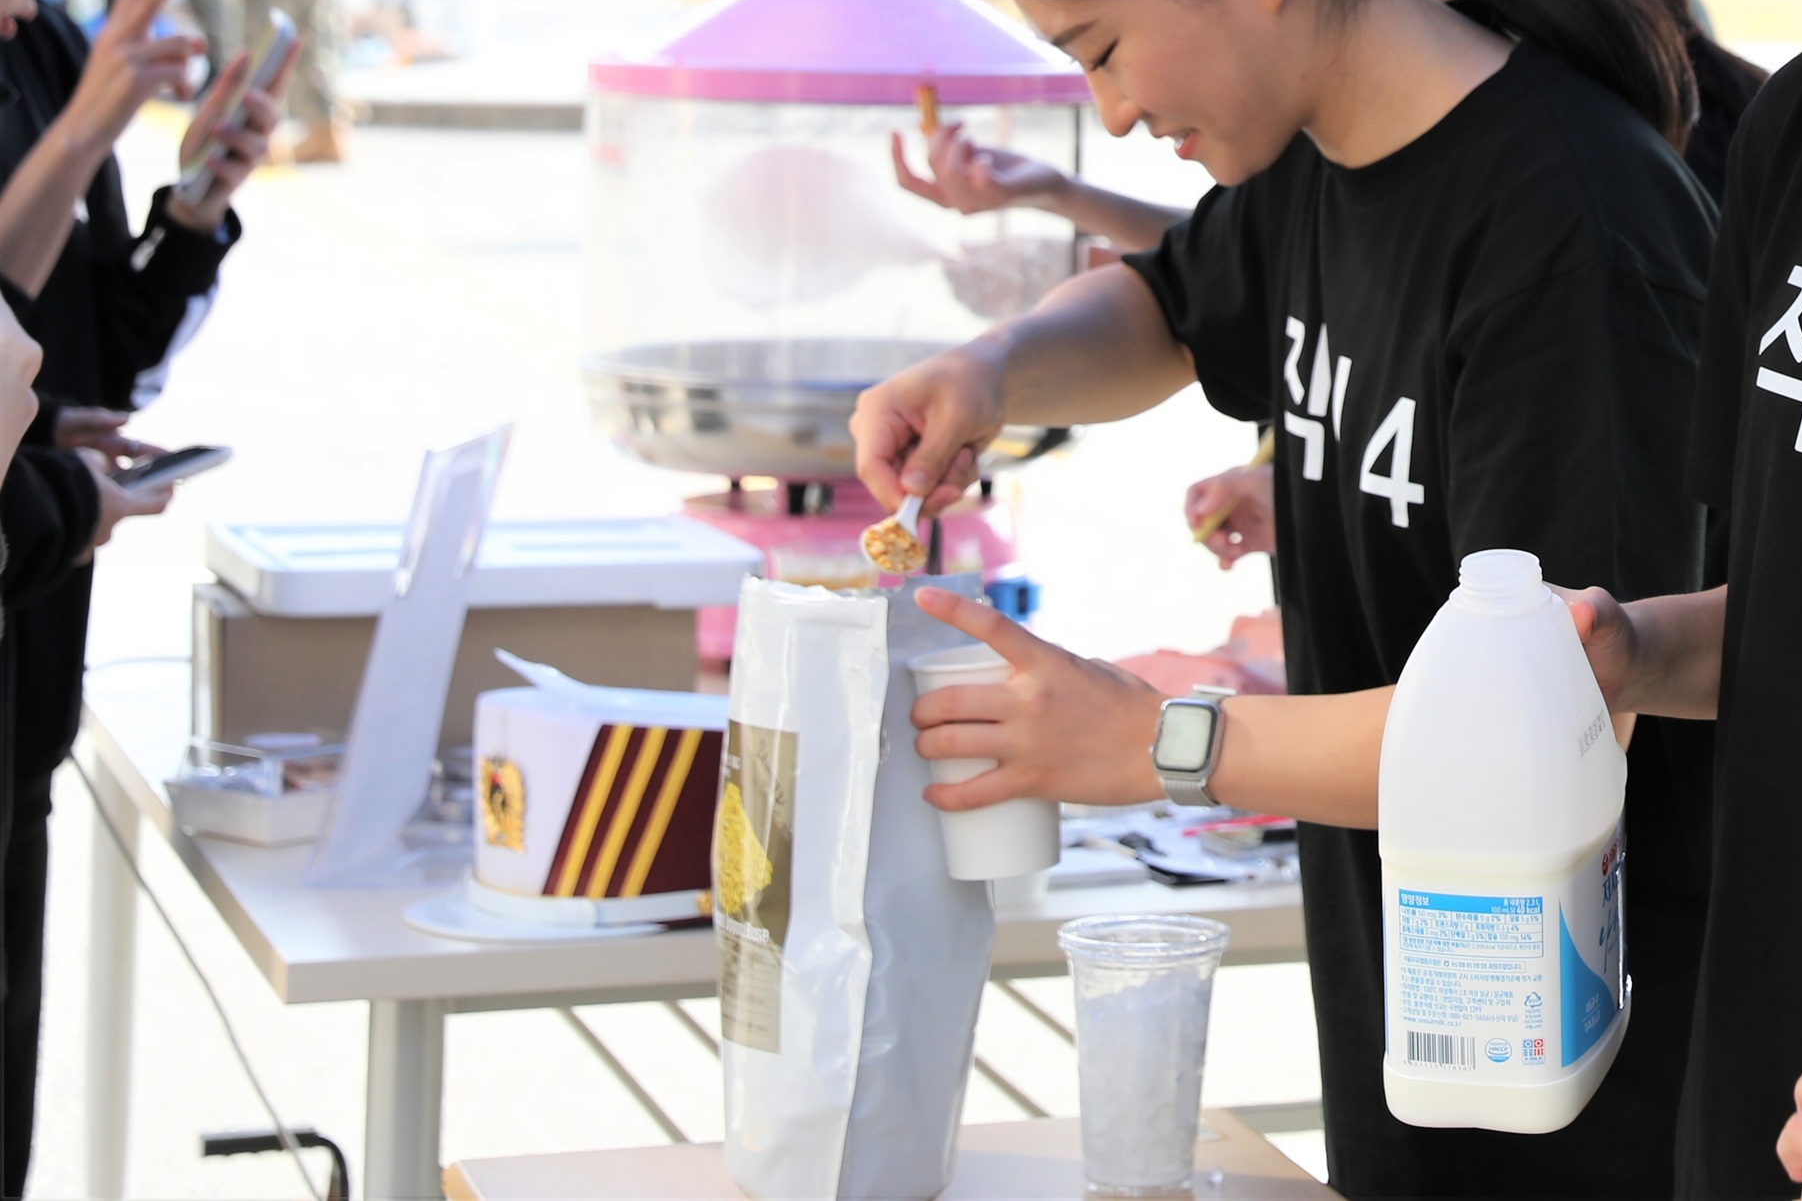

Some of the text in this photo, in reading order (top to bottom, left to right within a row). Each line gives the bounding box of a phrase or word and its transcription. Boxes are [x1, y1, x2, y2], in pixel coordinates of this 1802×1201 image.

[1401, 894, 1429, 906] 영양정보
[1491, 905, 1501, 914] 100
[1517, 906, 1526, 914] 40
[1527, 905, 1541, 914] kcal
[1420, 918, 1429, 926] 2%
